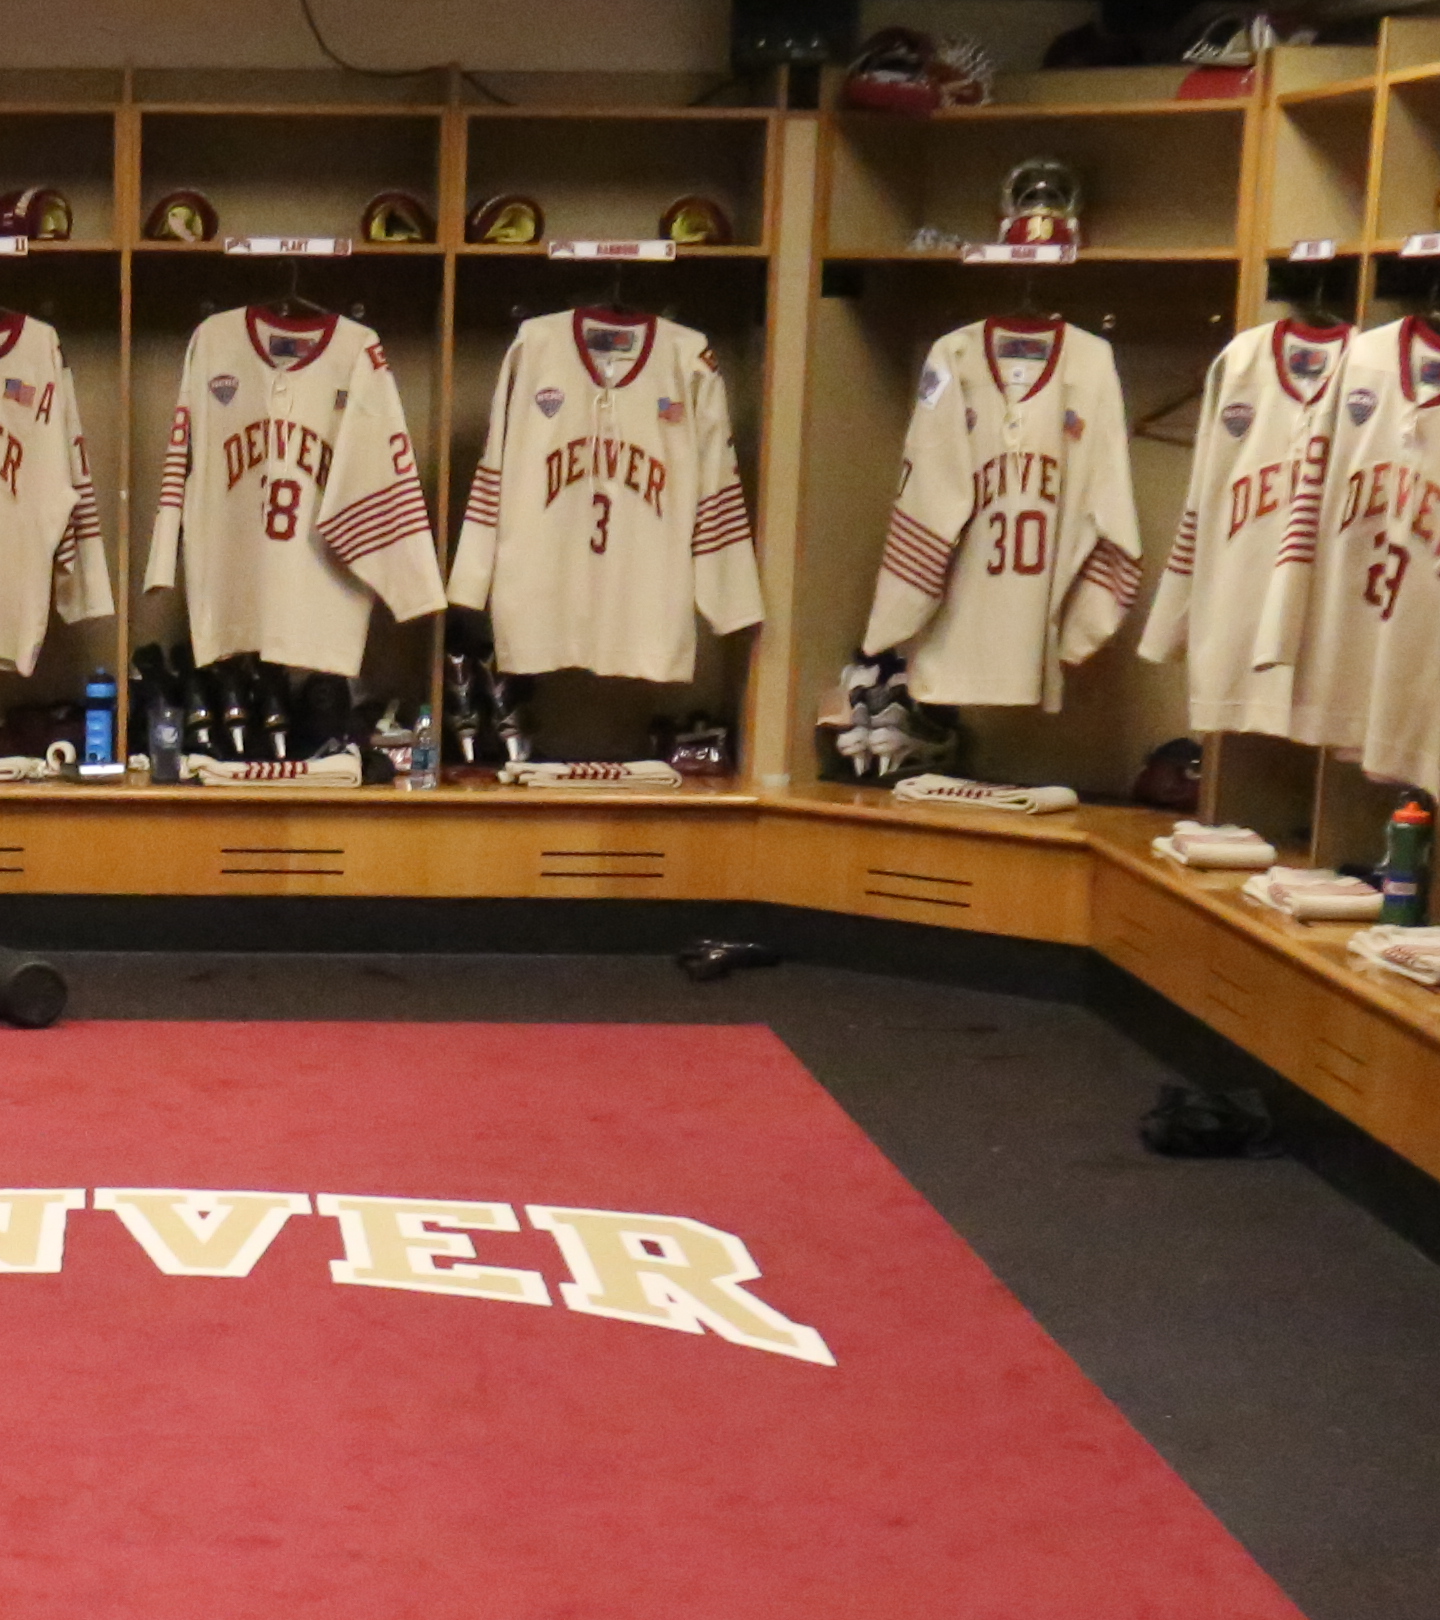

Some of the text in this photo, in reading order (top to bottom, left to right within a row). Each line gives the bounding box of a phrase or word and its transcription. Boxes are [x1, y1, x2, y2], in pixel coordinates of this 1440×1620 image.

[35, 381, 56, 425] A
[170, 405, 191, 447] 8
[74, 434, 91, 478] 1
[390, 431, 417, 475] 2
[588, 492, 613, 556] 3
[987, 509, 1047, 575] 30
